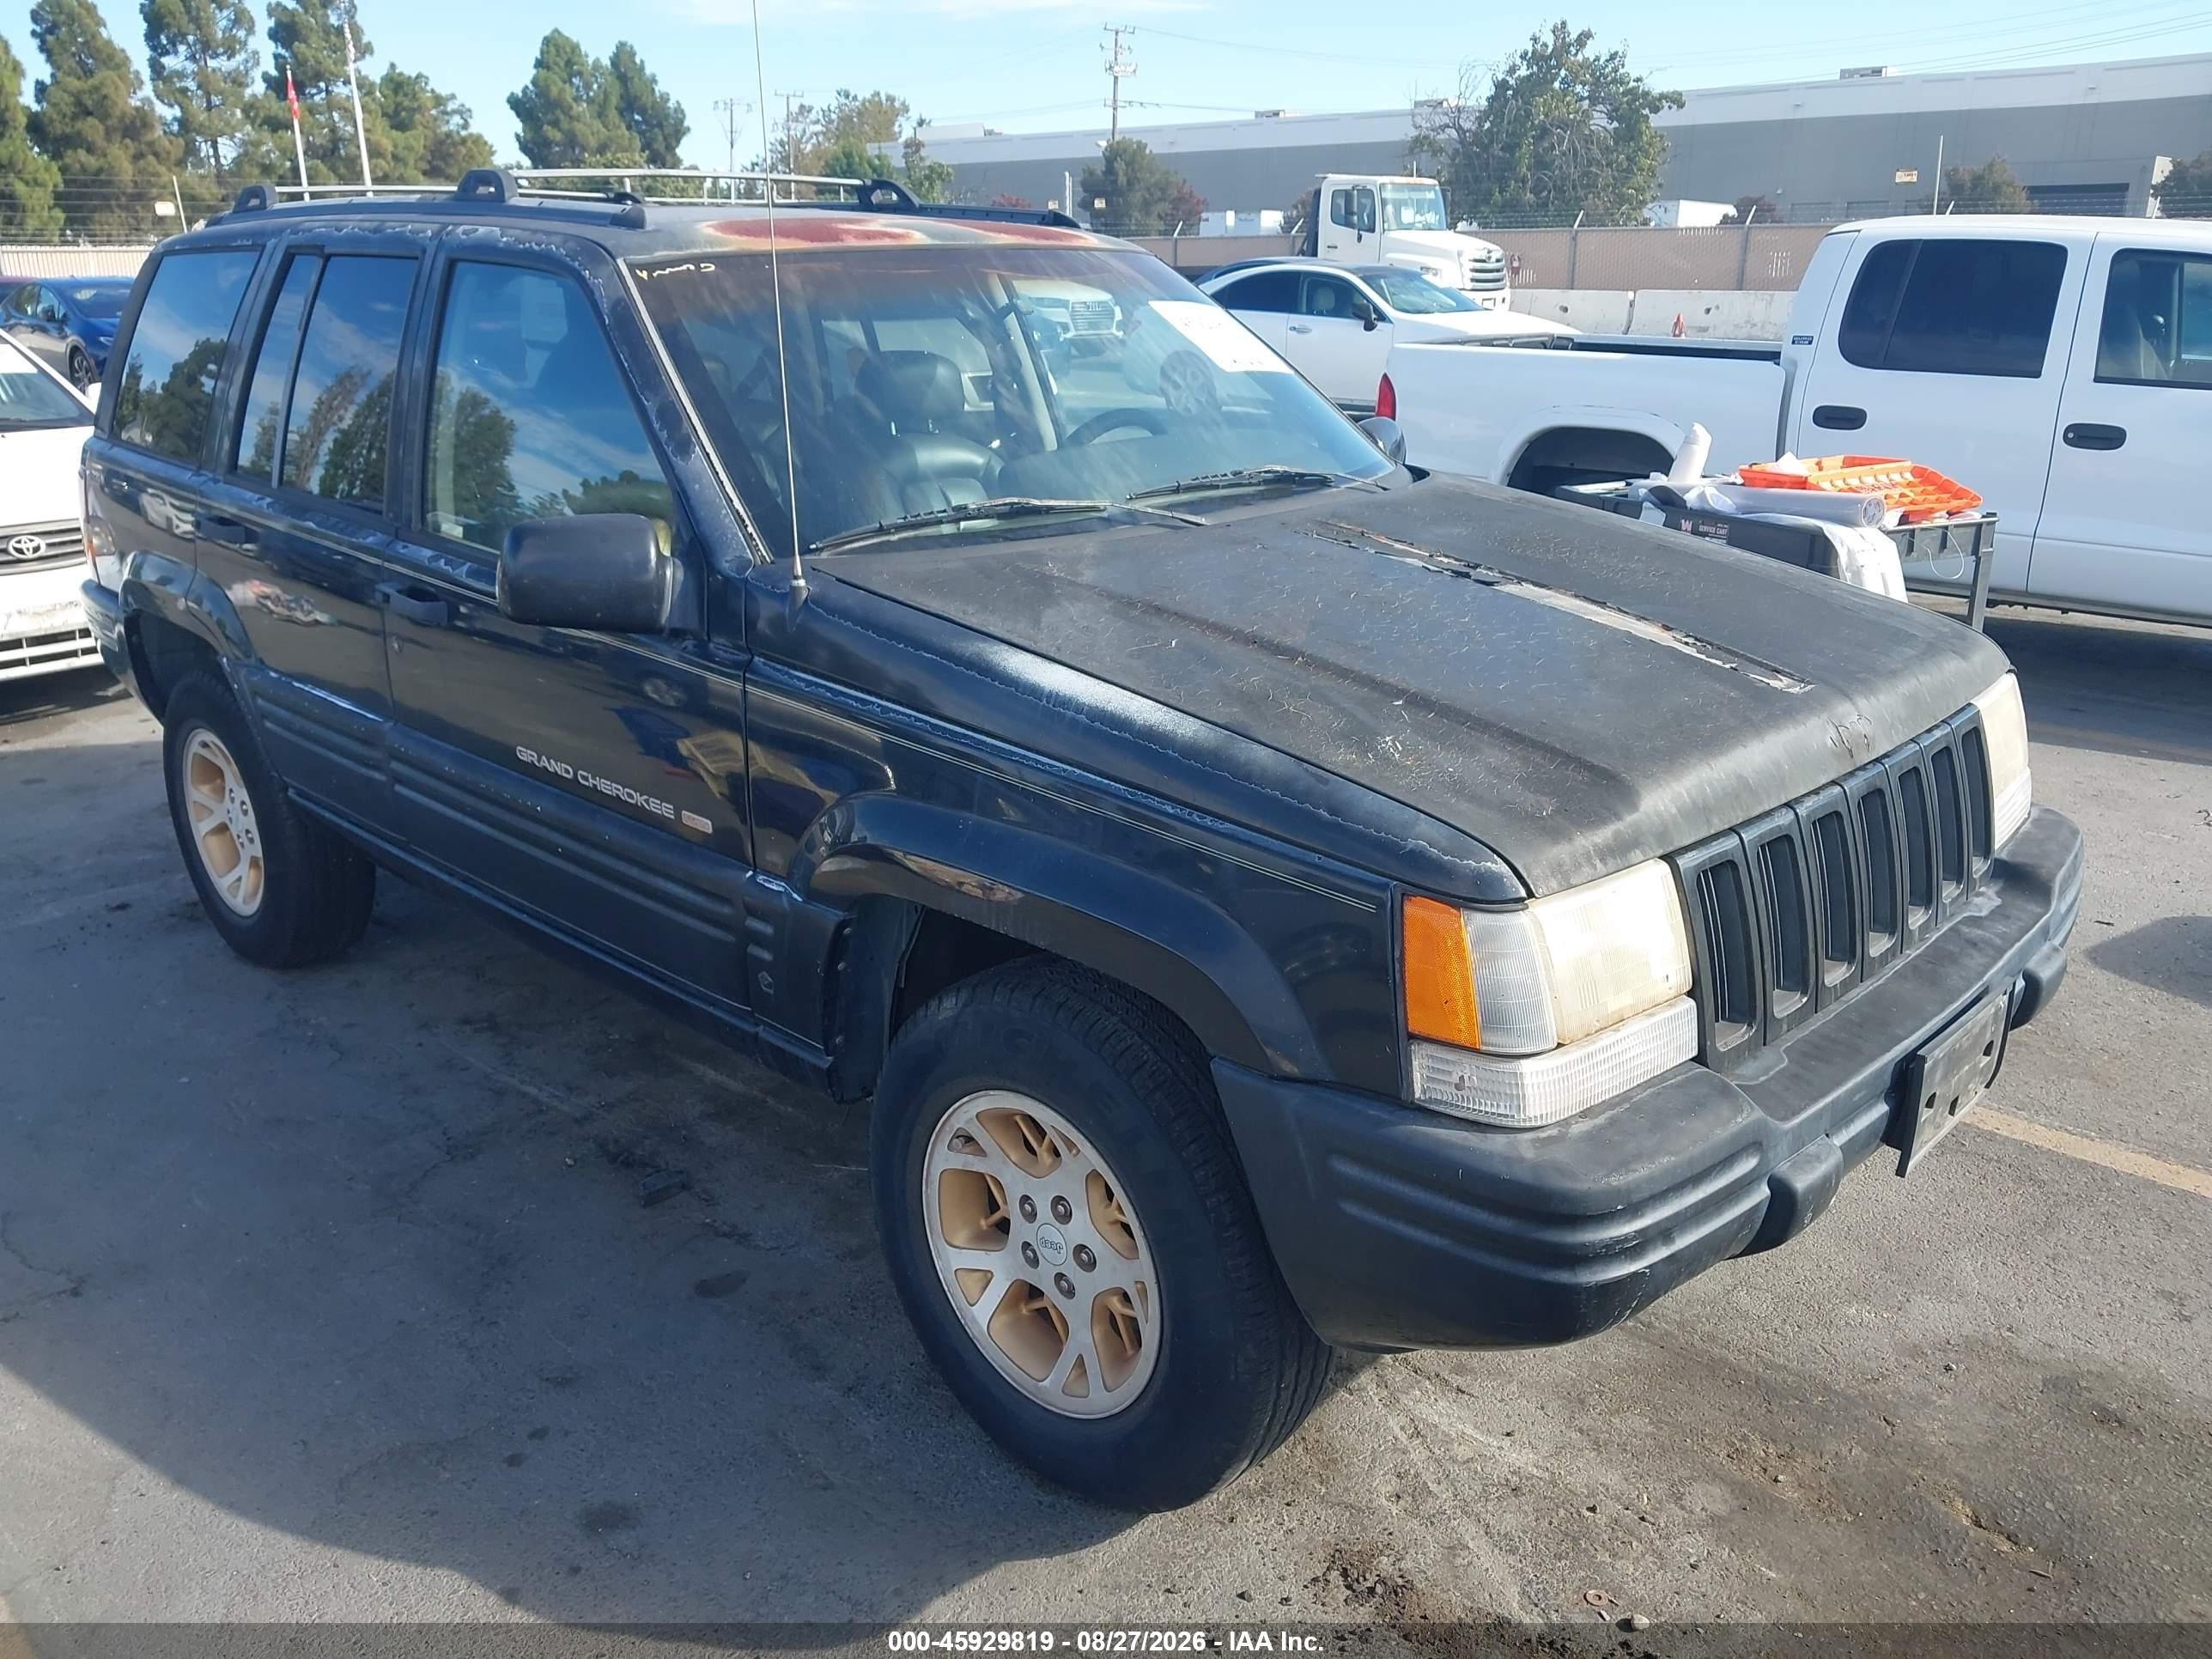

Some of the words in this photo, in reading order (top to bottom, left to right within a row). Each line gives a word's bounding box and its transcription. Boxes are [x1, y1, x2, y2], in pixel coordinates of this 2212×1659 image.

[515, 745, 574, 780] GRAND
[576, 769, 675, 820] CHEROKEE
[1040, 1237, 1063, 1254] Jeep
